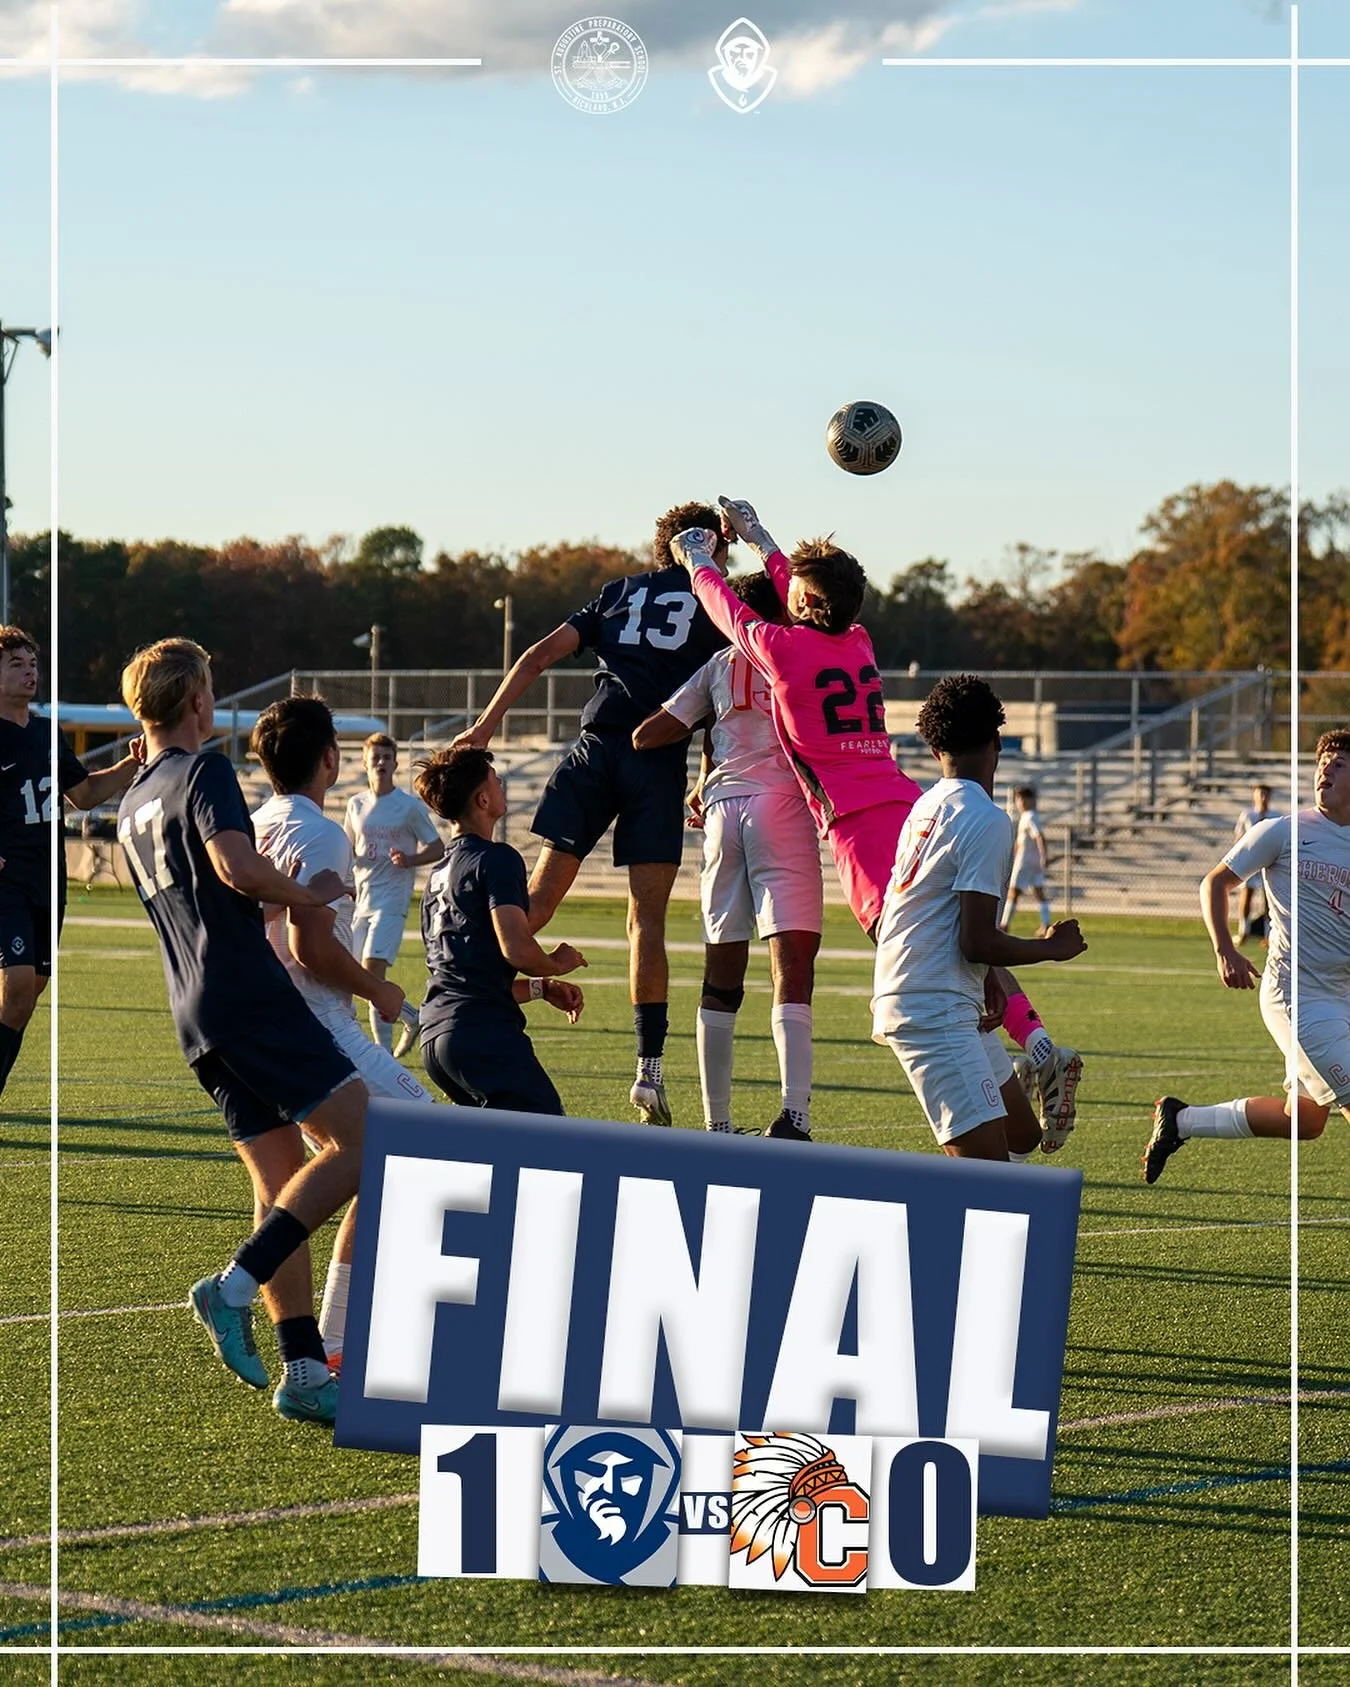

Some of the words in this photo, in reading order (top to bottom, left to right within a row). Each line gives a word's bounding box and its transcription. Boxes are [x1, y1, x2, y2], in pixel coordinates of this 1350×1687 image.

[618, 587, 698, 651] 13
[815, 665, 886, 736] 22
[20, 776, 61, 825] 12
[118, 797, 174, 902] 17
[367, 842, 378, 861] 8
[1298, 860, 1350, 887] HERO
[397, 1072, 425, 1098] C
[1329, 1064, 1350, 1087] C
[981, 1079, 999, 1108] C
